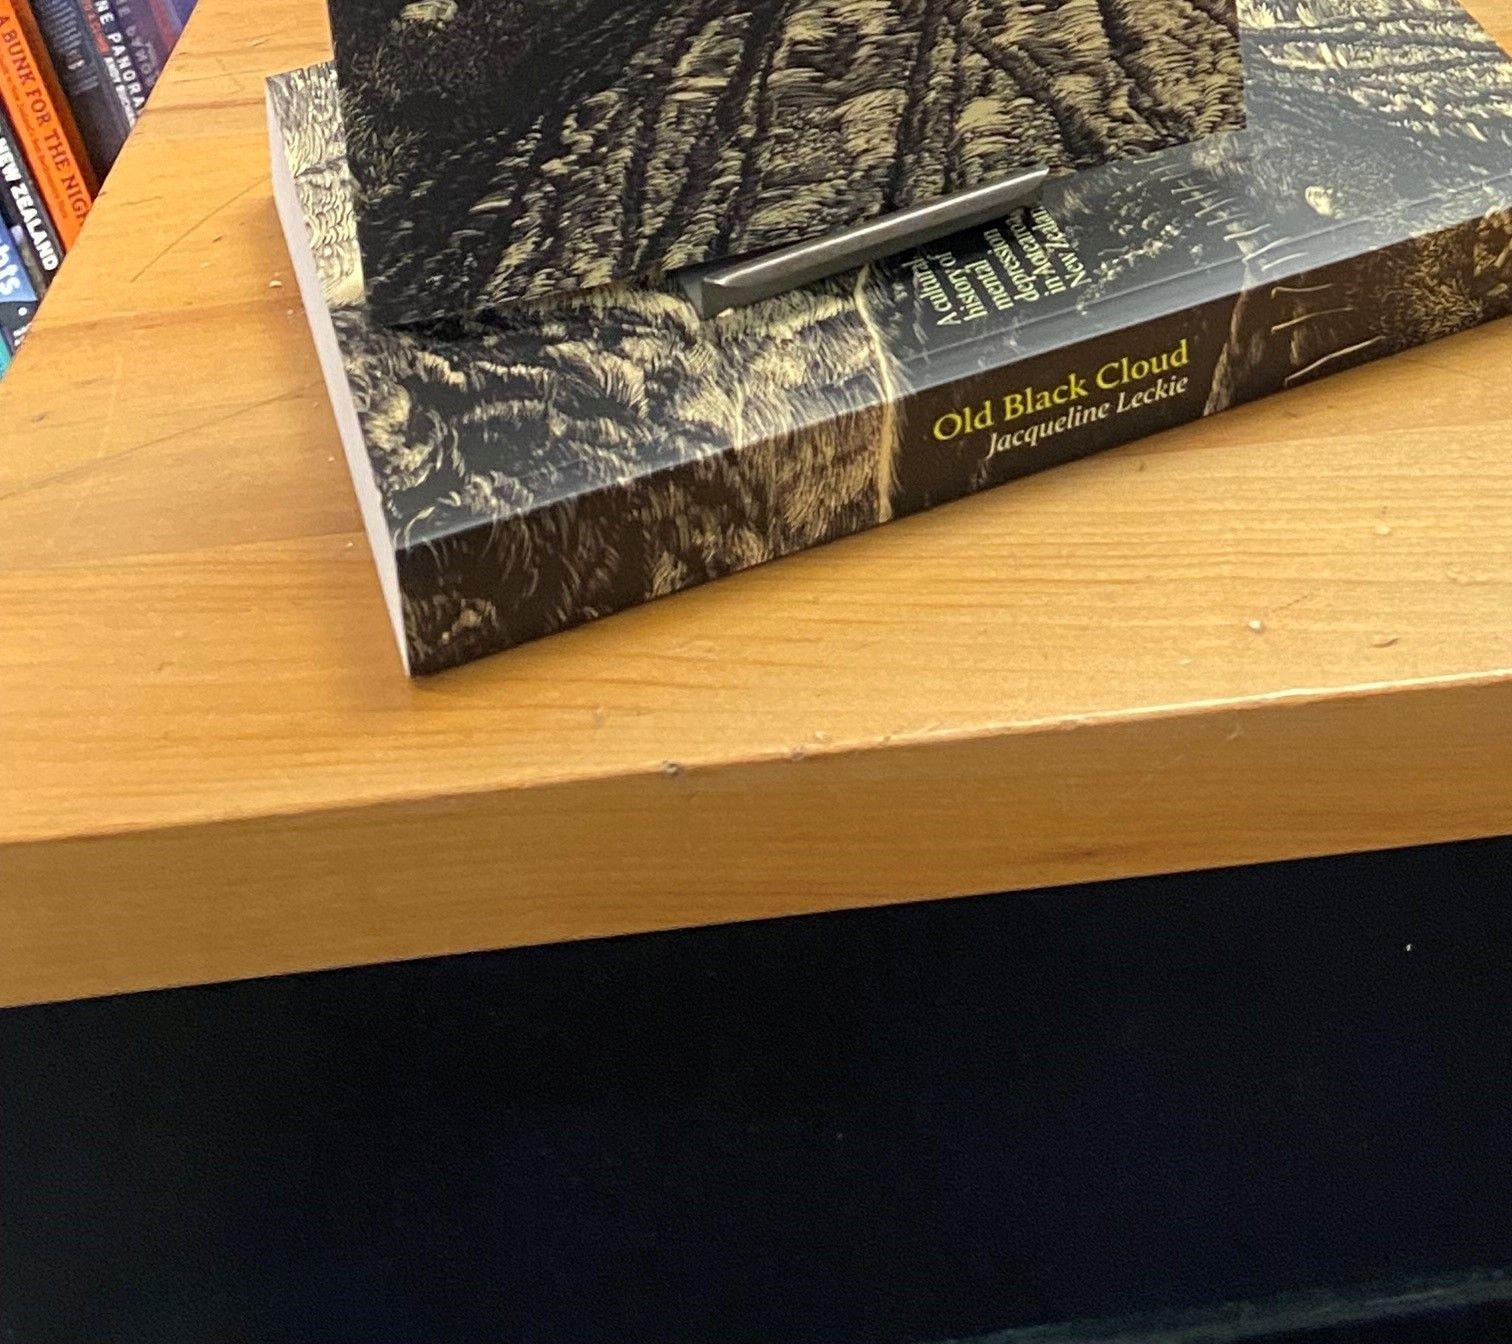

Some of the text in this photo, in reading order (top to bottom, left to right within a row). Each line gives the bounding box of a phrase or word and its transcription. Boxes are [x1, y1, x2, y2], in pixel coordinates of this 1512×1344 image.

[3, 30, 71, 171] BUNK FOR THE
[0, 136, 59, 271] NEW ZEALAND
[949, 267, 990, 323] history
[963, 258, 1016, 312] mental
[982, 226, 1041, 303] depression
[1043, 275, 1068, 297] in
[1058, 251, 1094, 290] New
[935, 310, 962, 327] A
[932, 337, 1191, 441] Old Black Cloud
[984, 374, 1190, 462] Jacqueline Leckie
